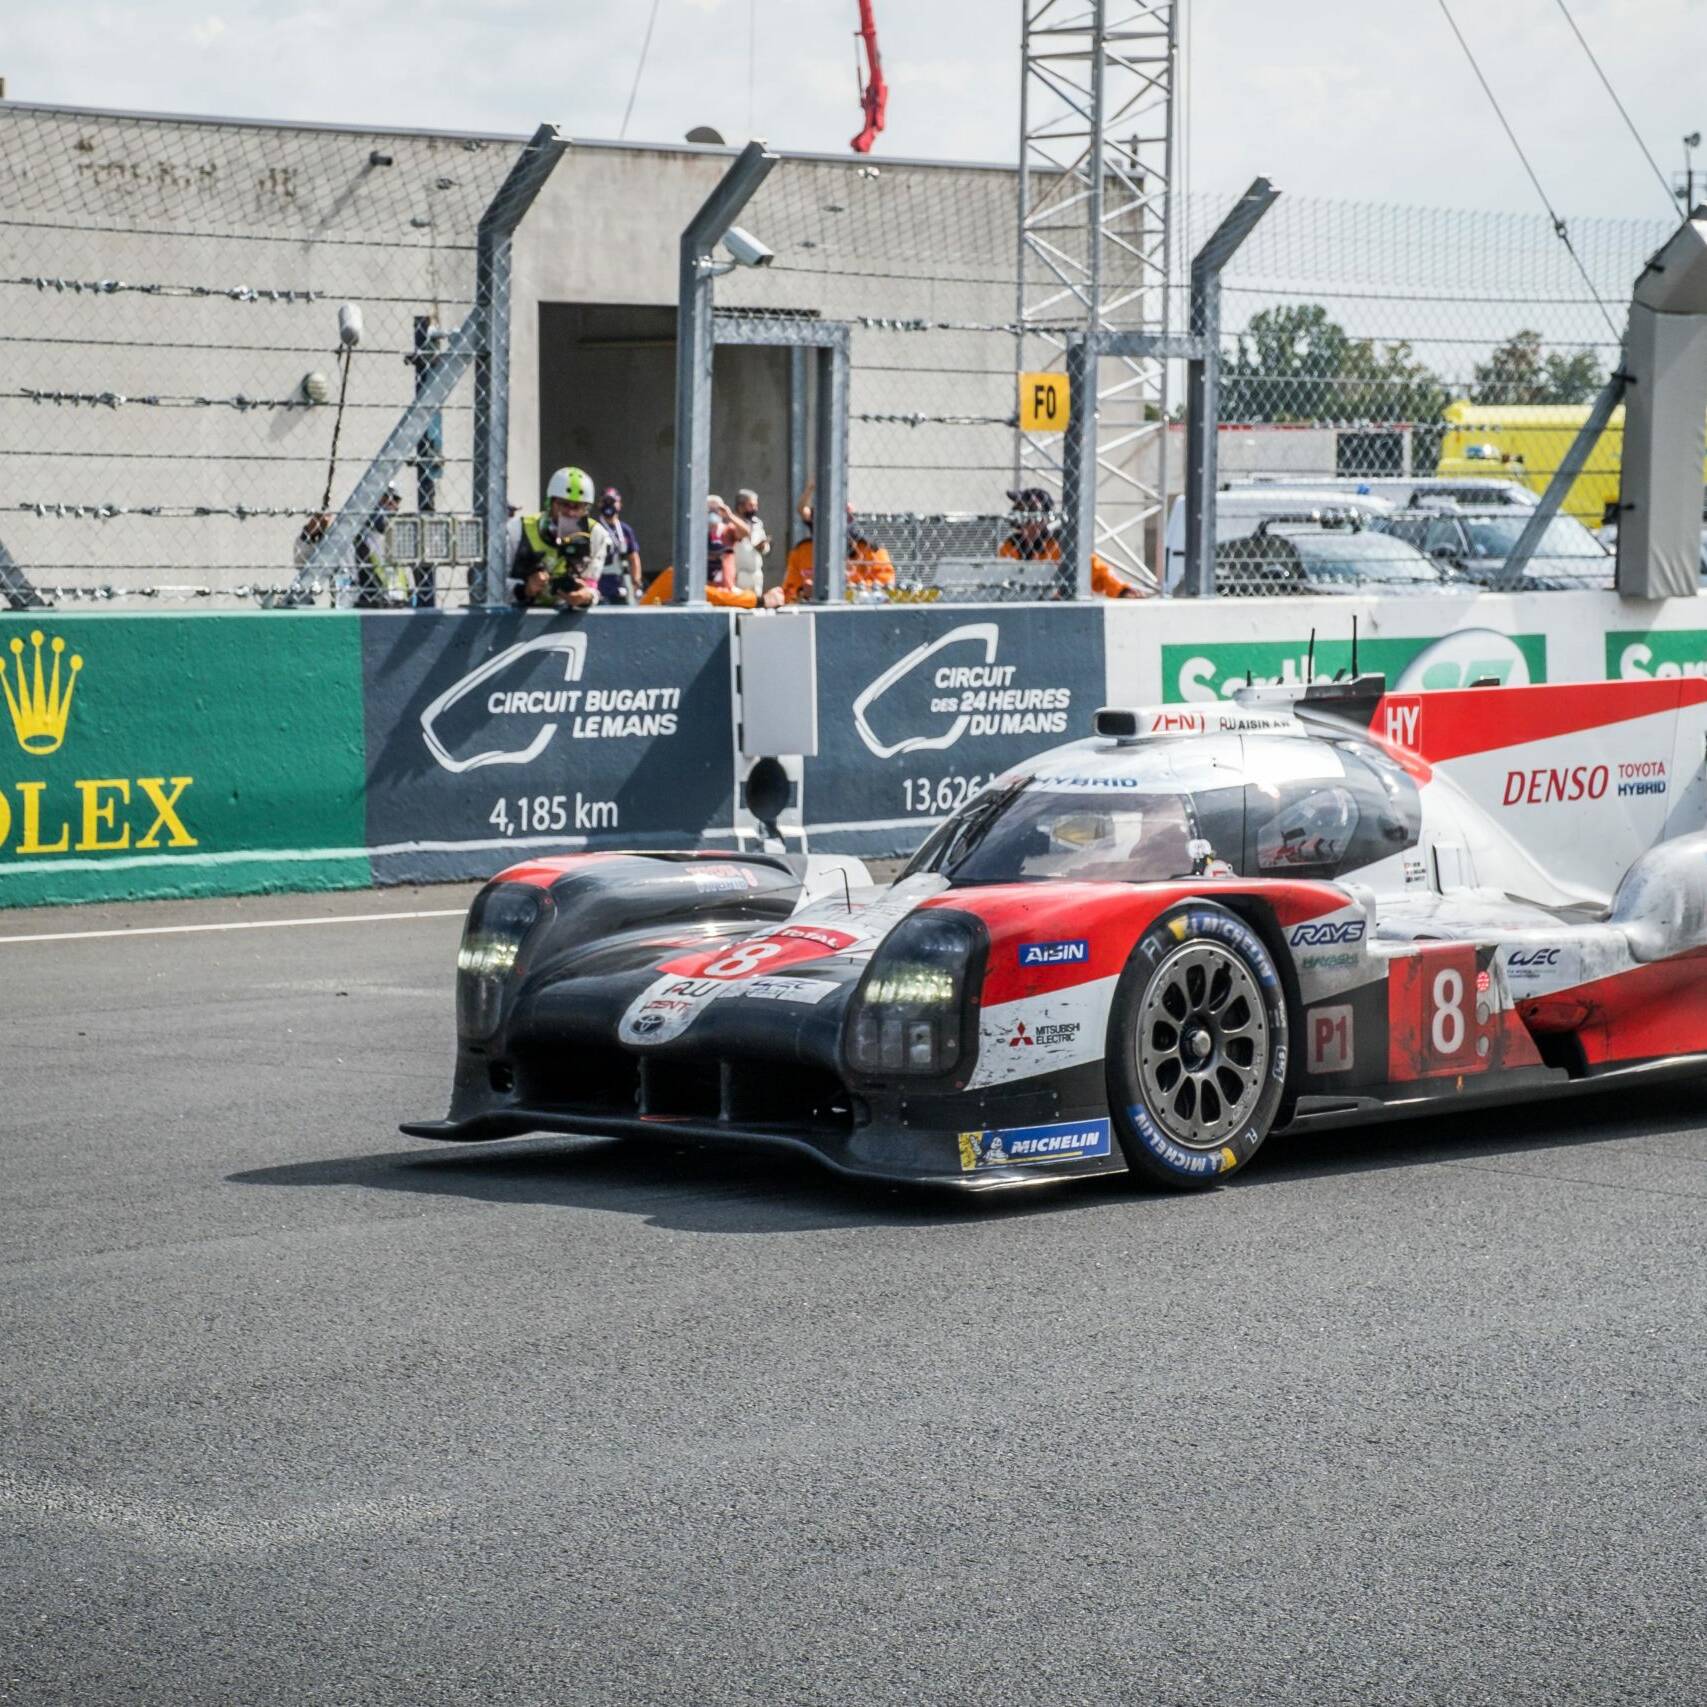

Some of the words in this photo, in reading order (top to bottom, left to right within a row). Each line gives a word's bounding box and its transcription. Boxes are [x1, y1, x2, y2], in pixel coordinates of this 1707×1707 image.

[935, 666, 1016, 689] CIRCUIT
[488, 691, 582, 714] CIRCUIT
[584, 688, 681, 712] BUGATTI
[930, 697, 959, 713] DES
[1386, 705, 1420, 746] HY
[1617, 761, 1666, 779] TOYOTA
[1503, 764, 1610, 807] DENSO
[1618, 781, 1667, 797] HYBRID
[0, 776, 199, 854] LEX
[489, 795, 567, 836] 4,185
[575, 792, 618, 829] km
[1289, 920, 1366, 946] RAYS
[703, 943, 783, 977] 8
[1025, 943, 1084, 963] AISIN
[1507, 948, 1561, 966] WEC
[1432, 968, 1465, 1054] 8
[1035, 1022, 1081, 1036] MITSUBISHI
[1036, 1033, 1076, 1045] ELECTRIC
[1316, 1016, 1348, 1063] P1
[1011, 1131, 1100, 1154] MICHELIN
[1135, 1112, 1207, 1172] MICHELIN
